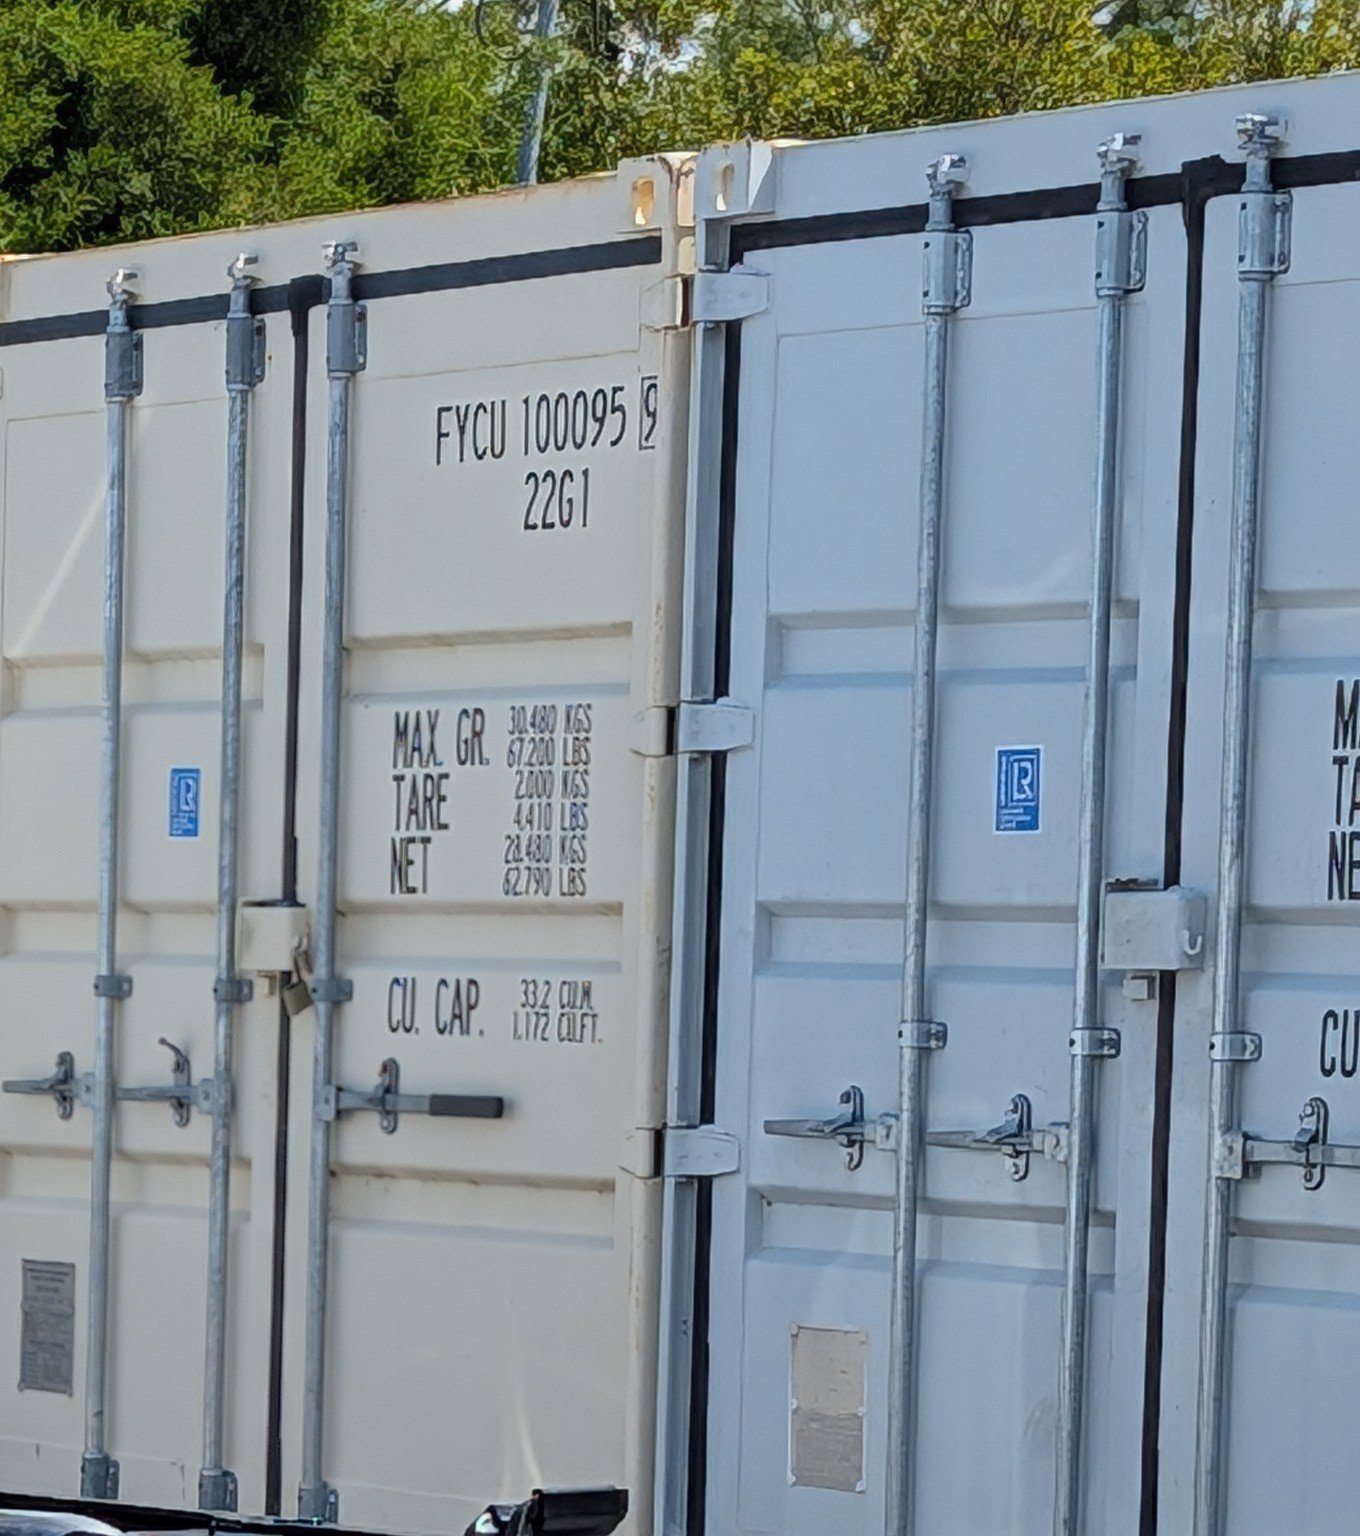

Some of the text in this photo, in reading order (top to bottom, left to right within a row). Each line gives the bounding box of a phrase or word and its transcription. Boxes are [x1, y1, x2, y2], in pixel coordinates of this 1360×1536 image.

[436, 399, 507, 466] FYCU
[522, 386, 627, 456] 100095
[524, 467, 589, 530] 22G1
[456, 707, 490, 766] GR.
[564, 703, 592, 734] KGS
[562, 736, 591, 766] LBS
[392, 772, 450, 831] TARE
[561, 768, 590, 800] KGS
[560, 802, 589, 831] LBS
[390, 836, 432, 894] NET
[559, 834, 587, 865] KGS
[559, 867, 587, 896] LBS
[388, 977, 419, 1035] CU.
[435, 978, 484, 1036] CAP.
[1320, 1009, 1360, 1078] CU
